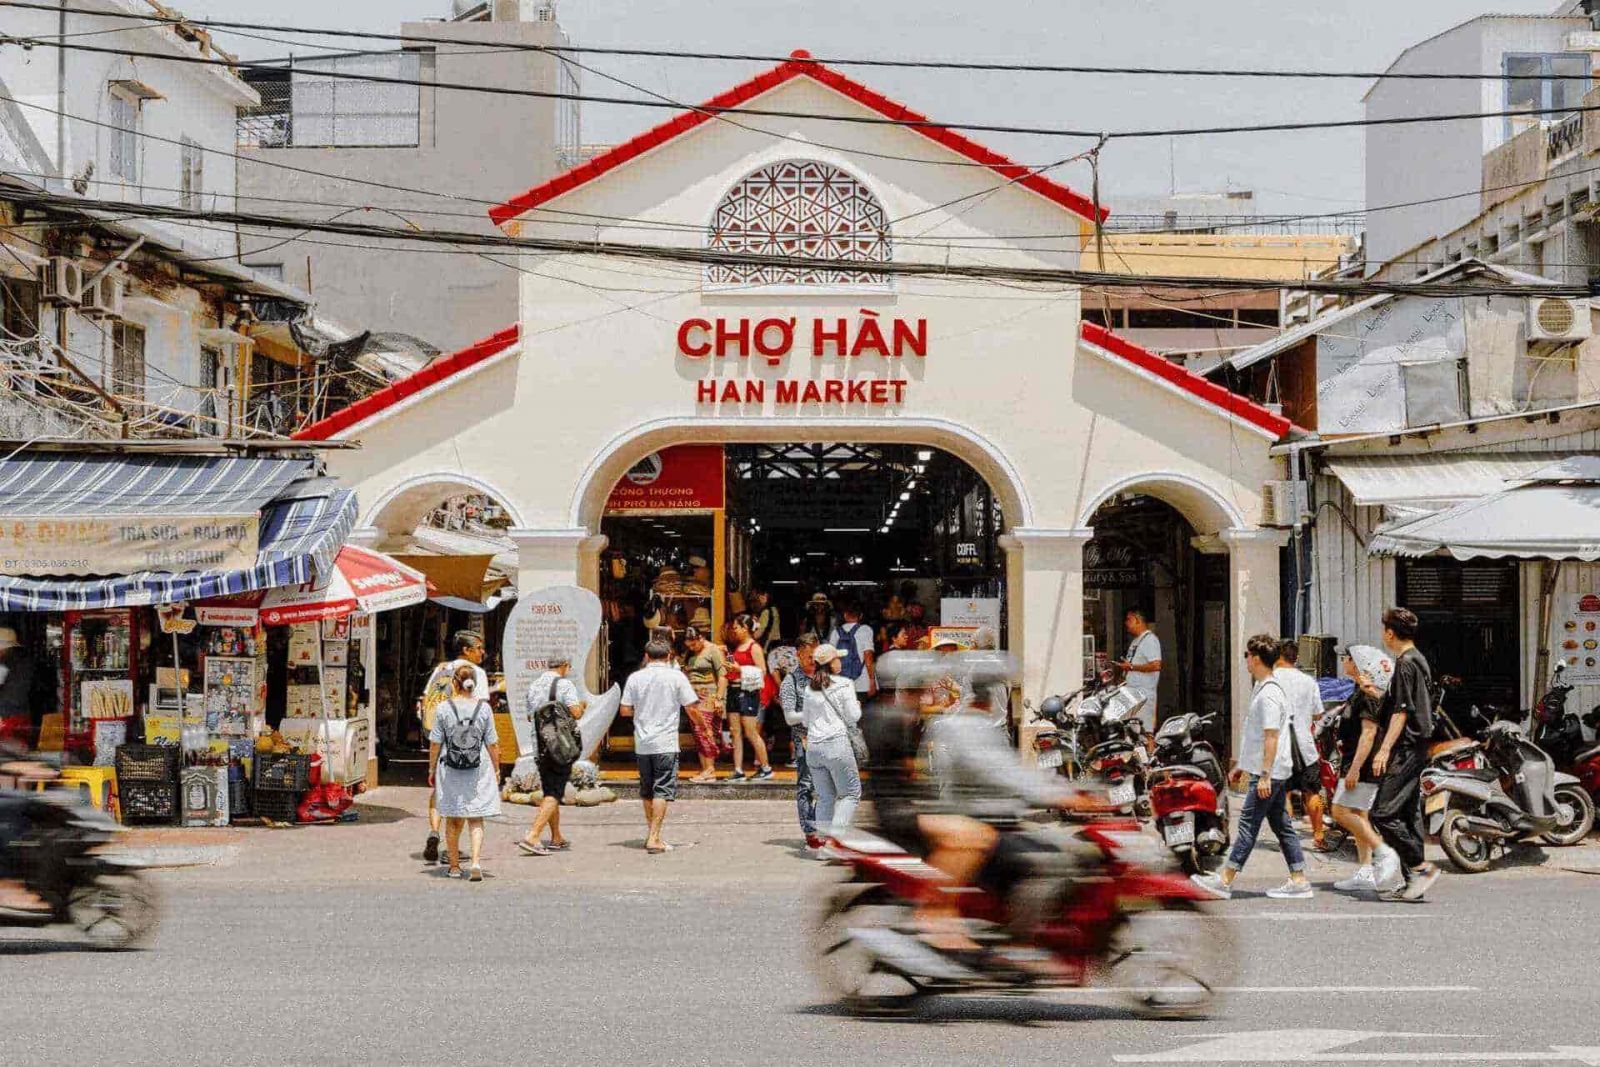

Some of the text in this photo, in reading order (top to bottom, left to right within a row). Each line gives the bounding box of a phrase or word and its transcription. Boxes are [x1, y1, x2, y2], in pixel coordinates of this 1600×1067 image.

[677, 308, 928, 366] CHỢ HÀN
[697, 379, 908, 403] HAN MARKET
